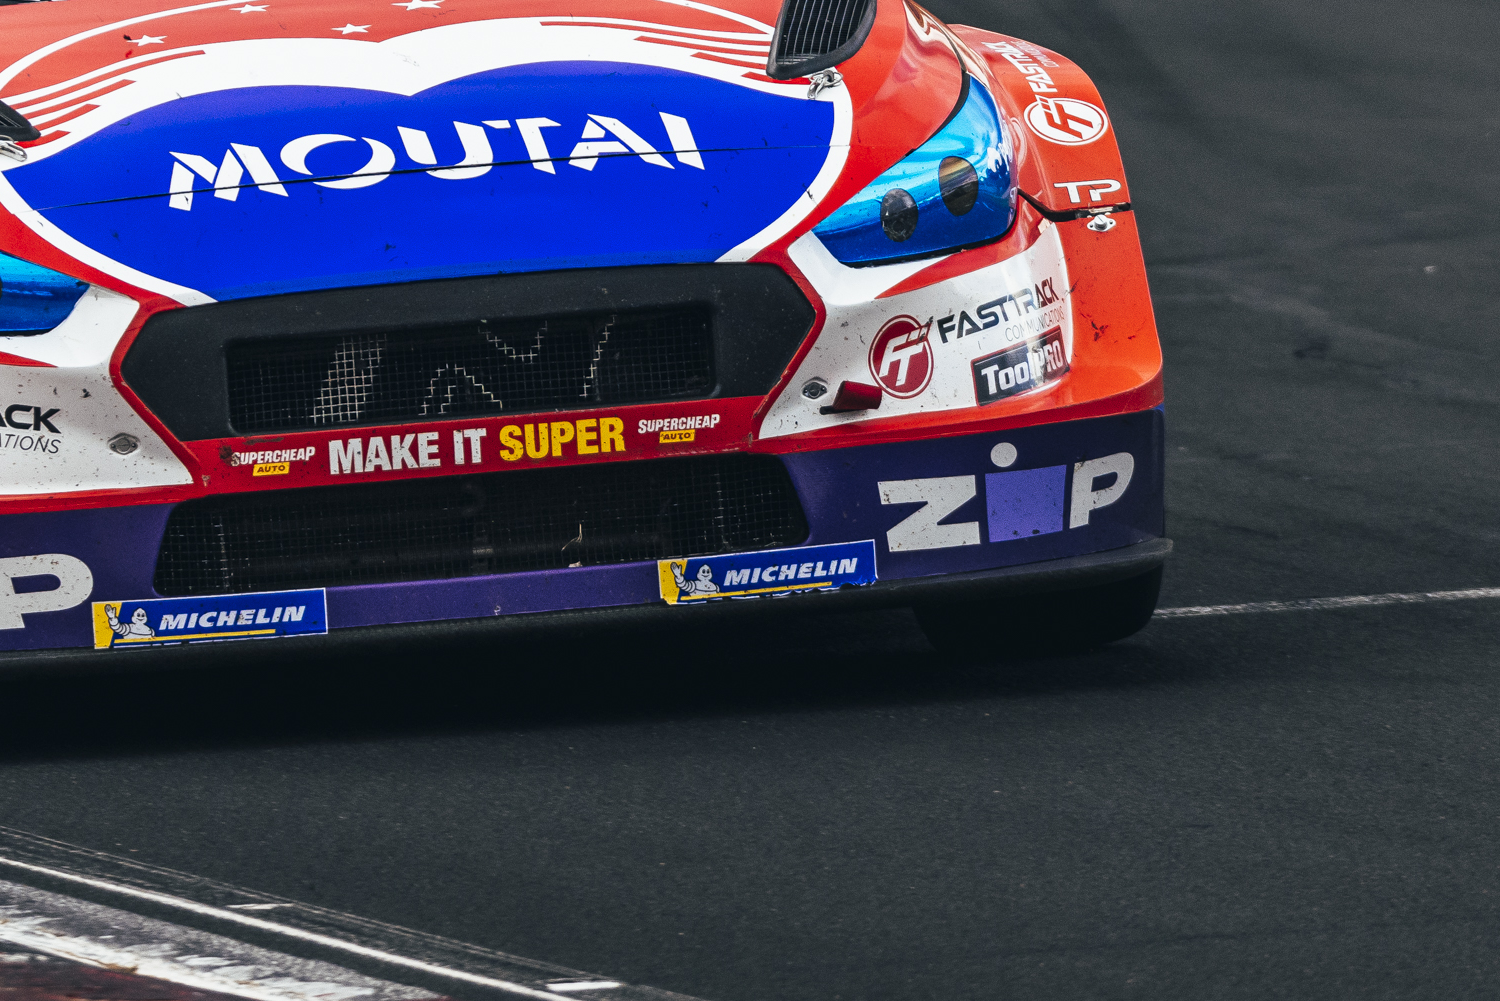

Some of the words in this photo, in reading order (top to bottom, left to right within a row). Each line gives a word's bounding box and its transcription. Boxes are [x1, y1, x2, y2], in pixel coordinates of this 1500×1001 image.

[168, 111, 705, 212] MOUTAI
[936, 276, 1059, 344] FASTTRACK
[980, 338, 1065, 396] ToolPRO
[638, 414, 720, 434] SUPERCHEAP
[662, 431, 694, 442] AUTO
[231, 445, 316, 467] SUPERCHEAP
[328, 432, 441, 475] MAKE
[453, 428, 487, 465] IT
[500, 417, 626, 461] SUPER
[256, 463, 287, 475] AUTO
[723, 557, 858, 587] MICHELIN
[159, 604, 307, 631] MICHELIN
